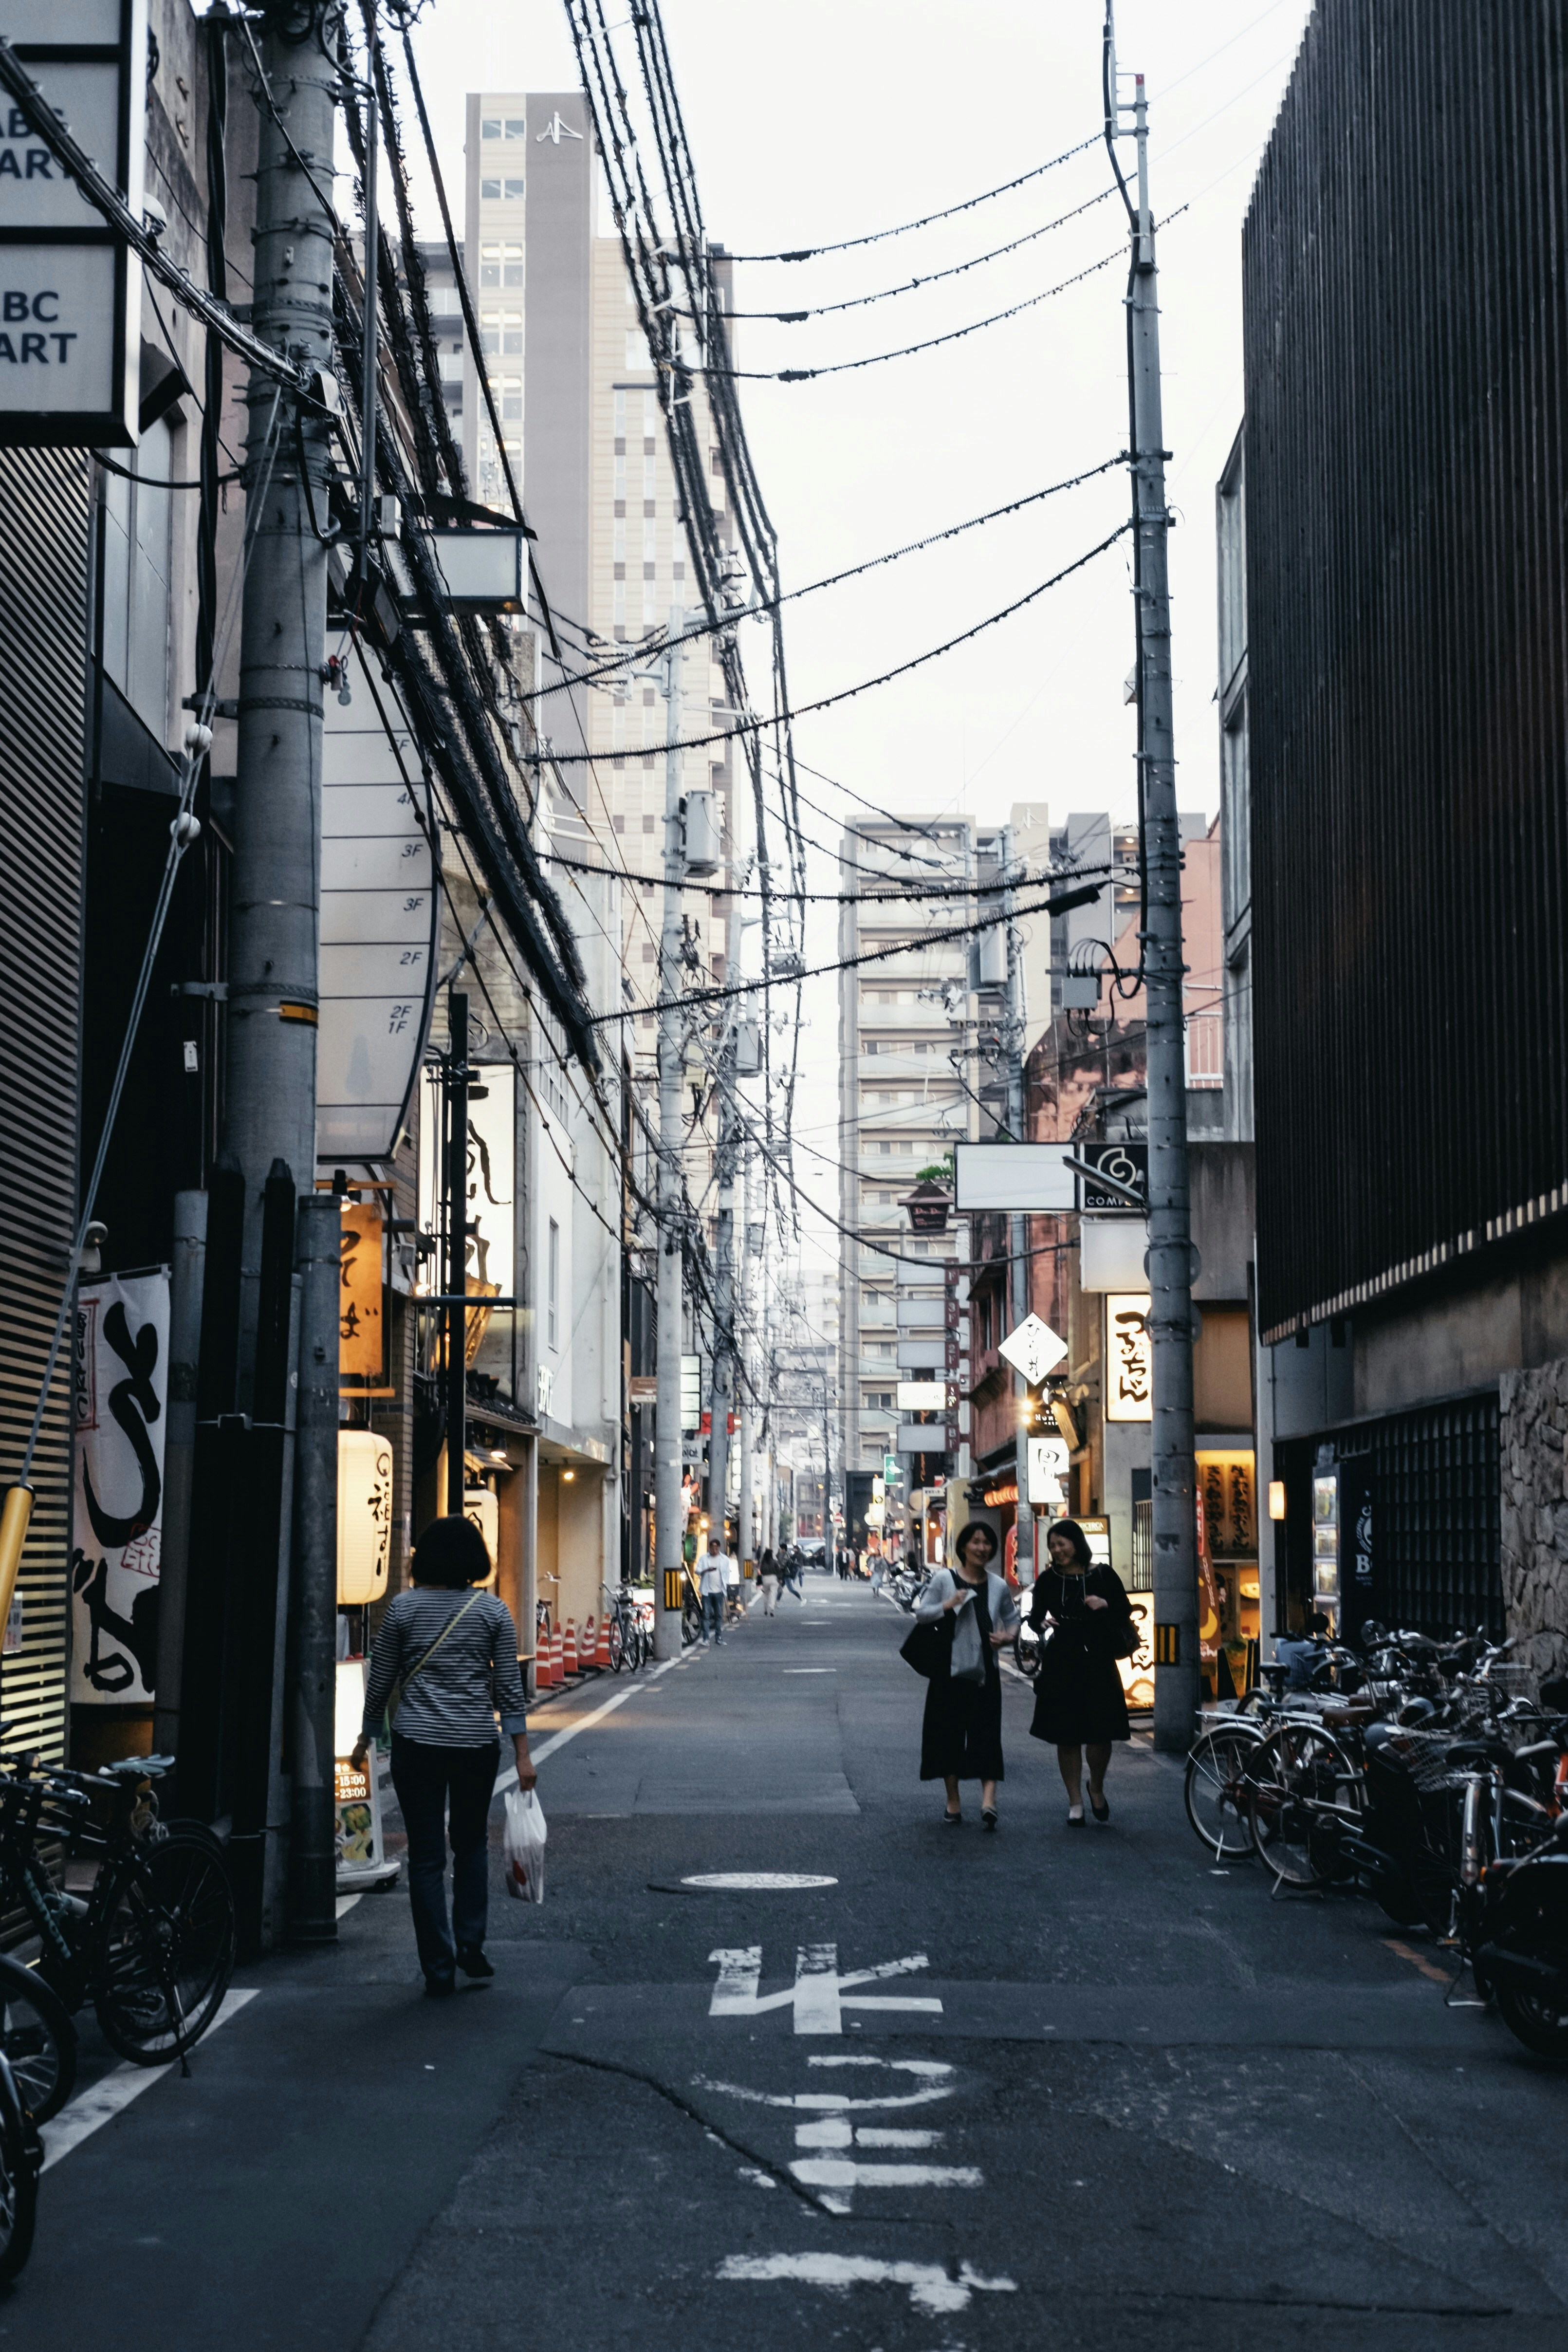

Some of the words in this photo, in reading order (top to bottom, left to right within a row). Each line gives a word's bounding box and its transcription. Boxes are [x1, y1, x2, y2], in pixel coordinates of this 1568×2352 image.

[0, 149, 71, 179] AR
[401, 844, 424, 858] 3F
[403, 898, 424, 911] 3F
[400, 952, 423, 965] 2F
[390, 1006, 412, 1019] 2F
[388, 1021, 408, 1035] 1F
[1087, 1196, 1132, 1206] COMP
[1355, 1553, 1373, 1574] B
